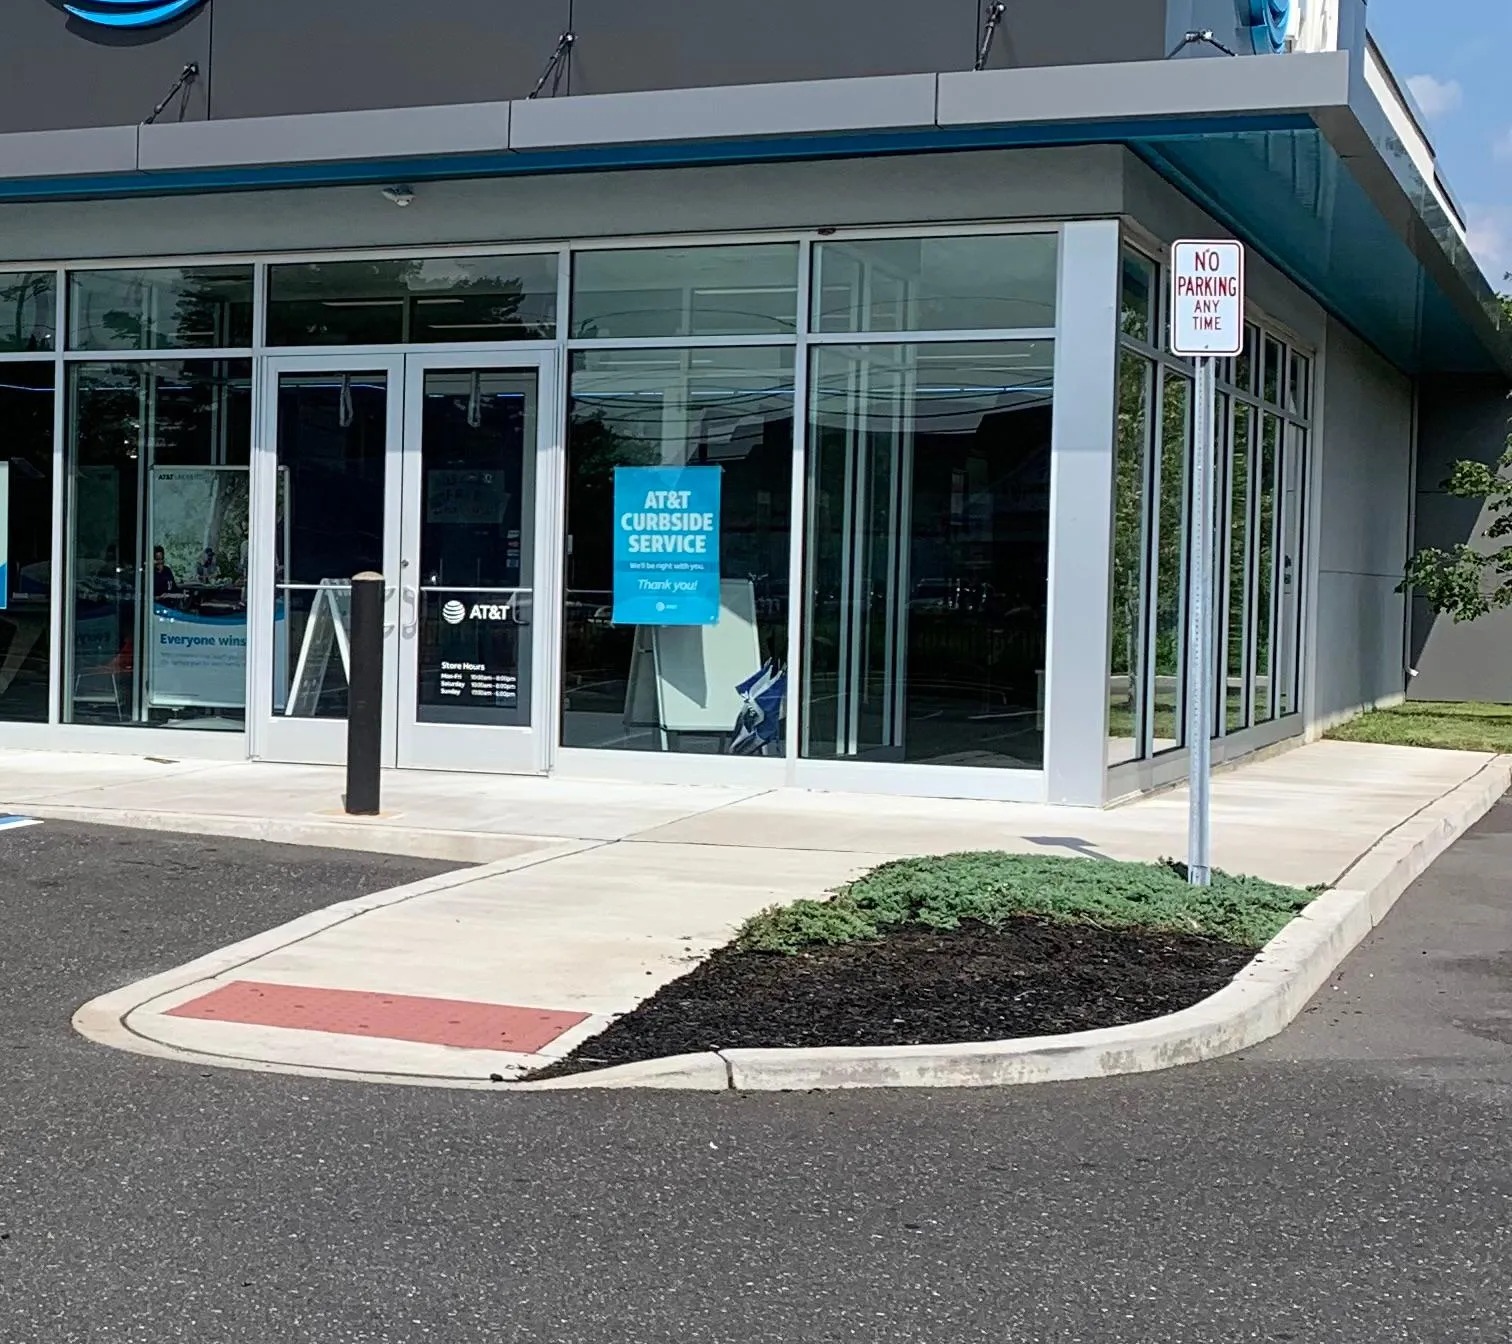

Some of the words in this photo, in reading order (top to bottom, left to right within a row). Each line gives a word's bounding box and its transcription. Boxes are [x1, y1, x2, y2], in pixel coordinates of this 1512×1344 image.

[1195, 251, 1219, 271] NO
[1178, 276, 1236, 296] PARKING
[1194, 300, 1220, 313] ANY
[1192, 317, 1221, 330] TIME
[644, 491, 691, 509] AT&T
[621, 513, 713, 531] CURBSIDE
[628, 535, 706, 553] SERVICE
[656, 562, 672, 570] right
[638, 579, 671, 590] Thank
[672, 579, 698, 592] you!
[469, 604, 510, 620] AT&T
[160, 634, 215, 647] Everyone
[219, 635, 246, 646] wins
[441, 661, 462, 669] Store
[463, 662, 485, 671] Hours
[440, 680, 465, 688] Saturday
[440, 688, 461, 696] Sunday
